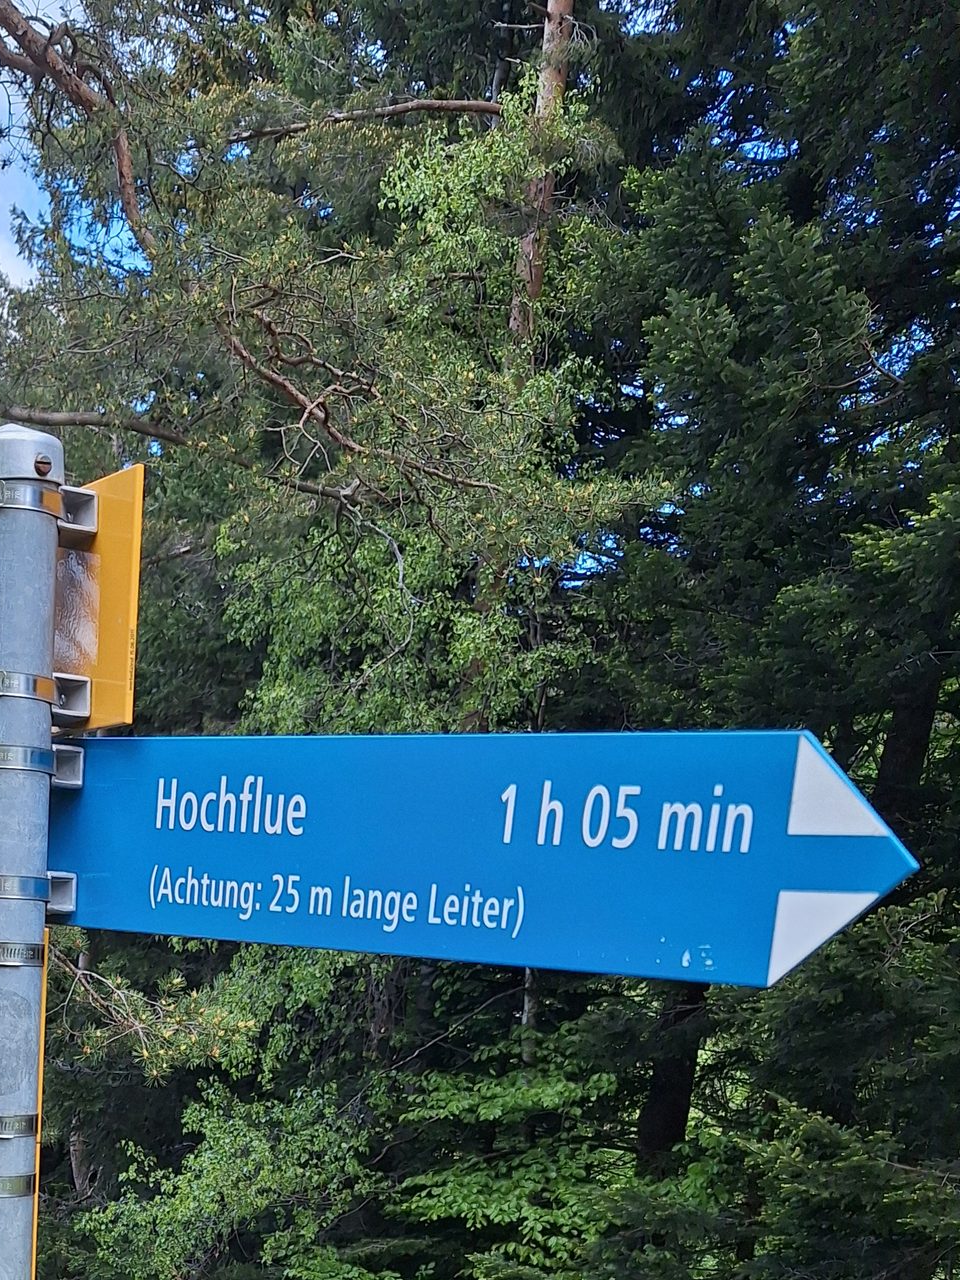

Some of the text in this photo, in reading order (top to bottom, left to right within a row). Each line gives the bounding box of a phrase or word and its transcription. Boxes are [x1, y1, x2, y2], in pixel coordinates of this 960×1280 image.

[156, 775, 753, 853] Hochflue 1 h 05 min
[149, 864, 524, 938] (Achtung: 25 m lange Leiter)
